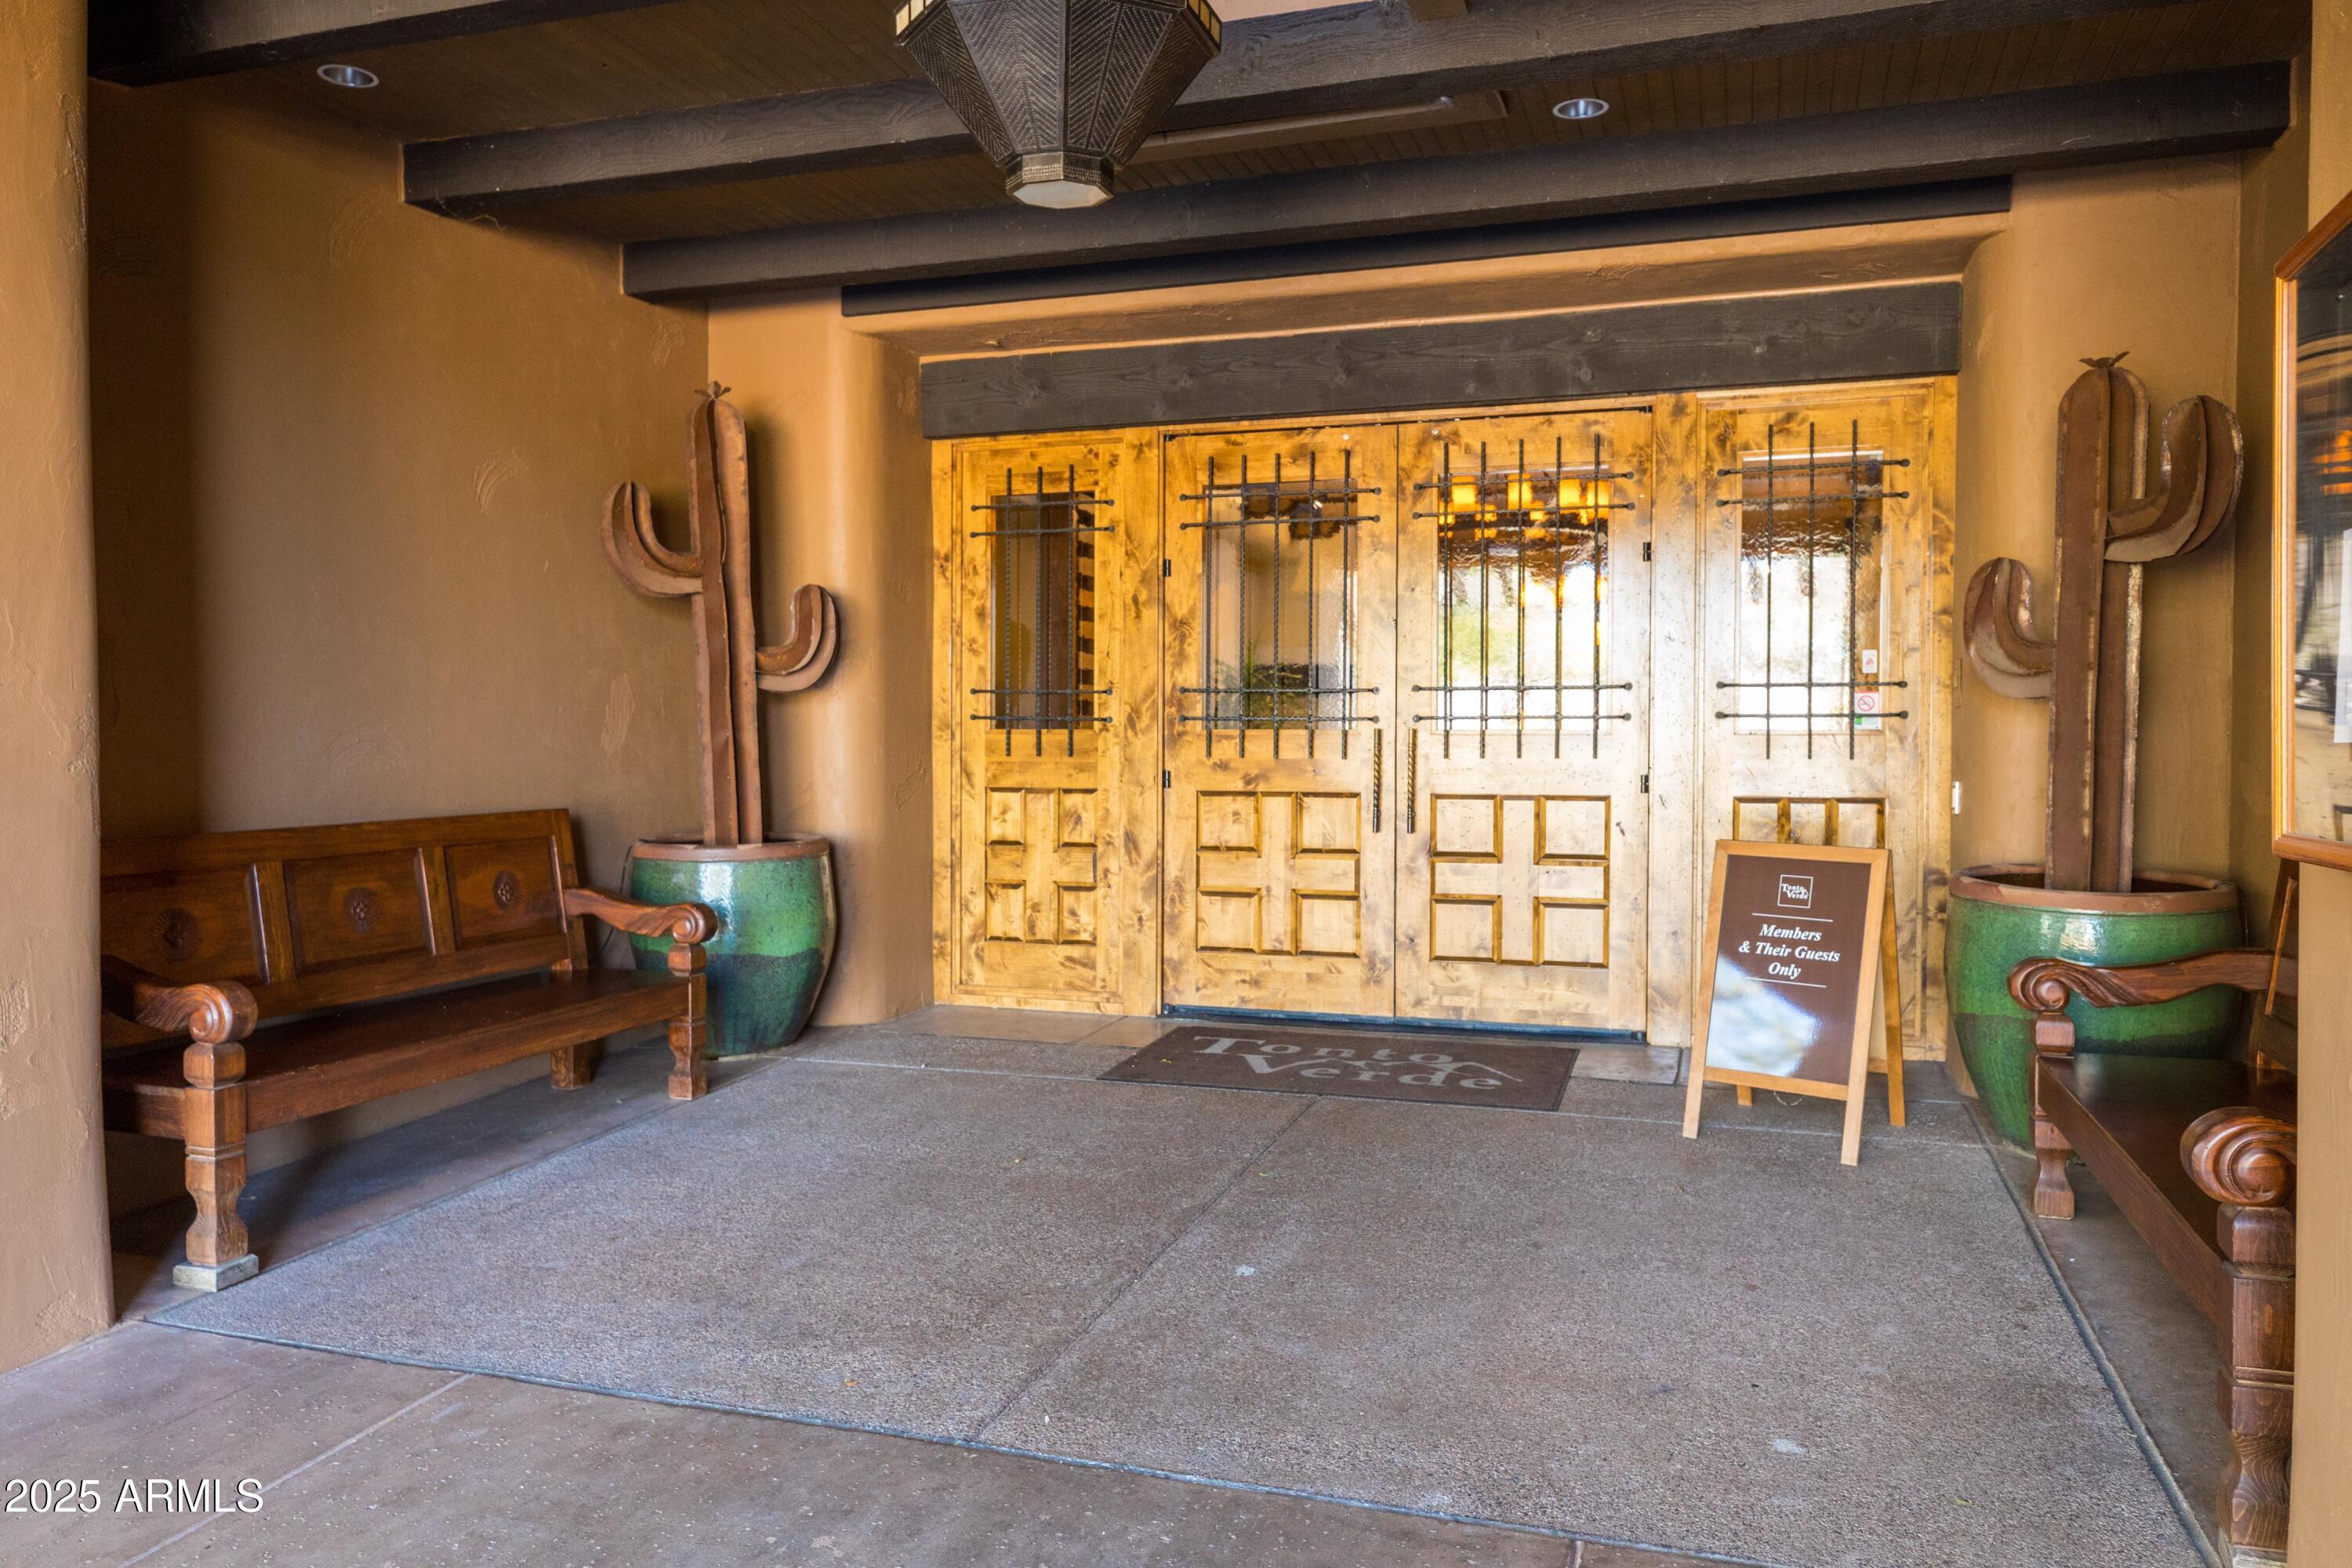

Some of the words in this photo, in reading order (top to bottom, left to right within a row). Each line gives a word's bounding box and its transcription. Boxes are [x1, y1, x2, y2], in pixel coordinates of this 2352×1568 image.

[1787, 889, 1809, 899] Verde
[1759, 924, 1822, 942] Members
[1738, 941, 1751, 953] &
[1755, 942, 1791, 956] Their
[1795, 946, 1841, 962] Guests
[1768, 962, 1802, 979] Only
[1192, 1036, 1453, 1064] Tonto
[1236, 1054, 1504, 1090] Verde
